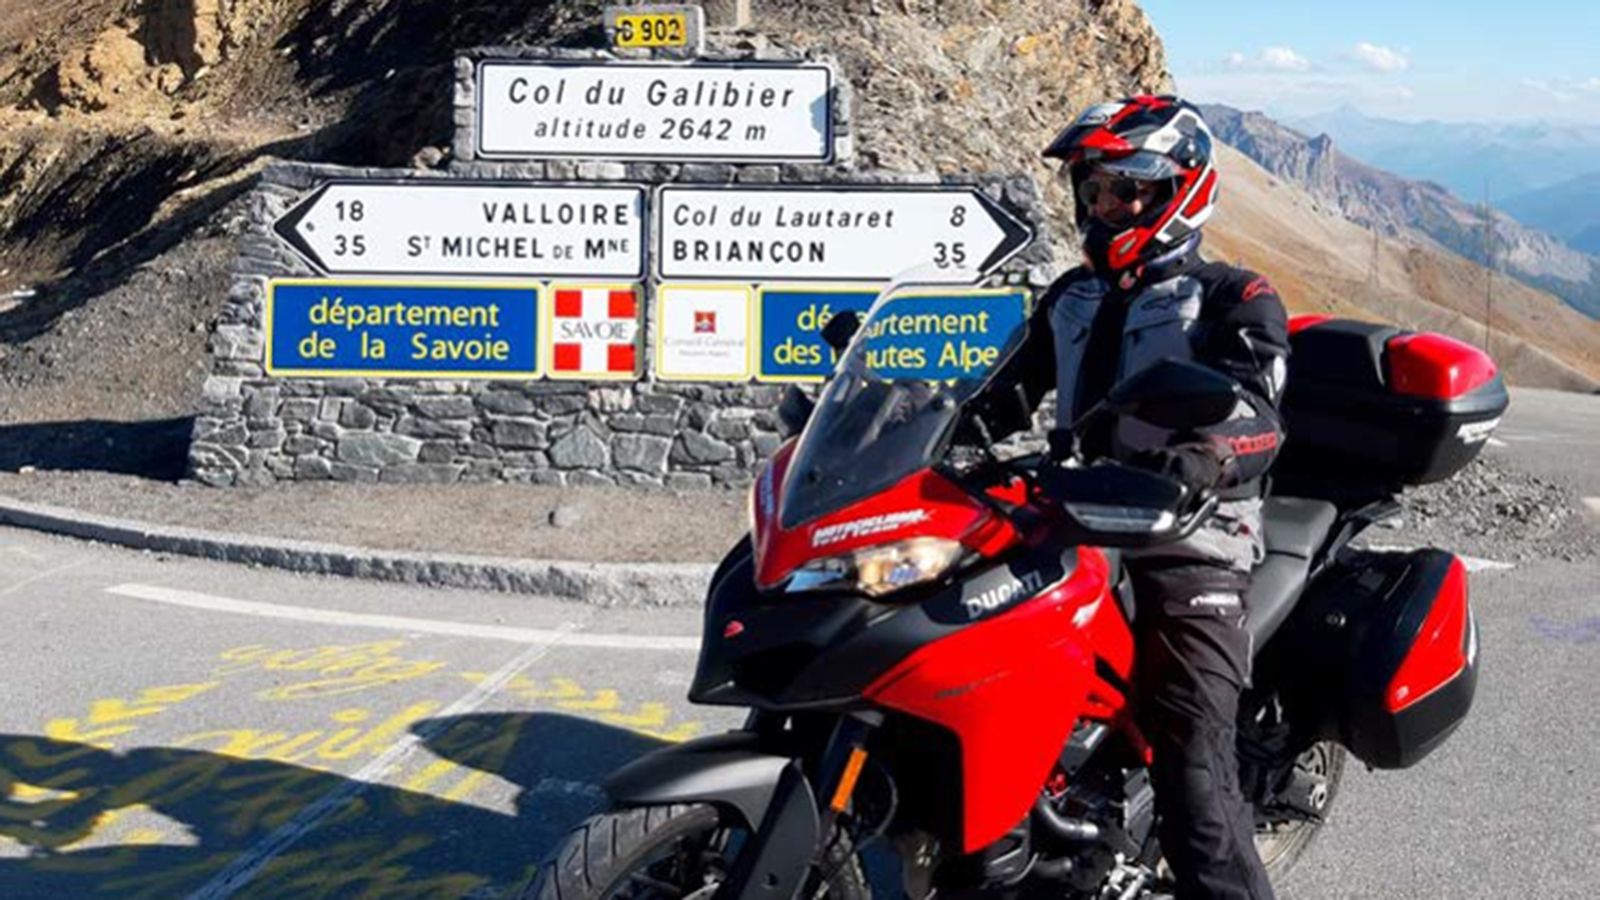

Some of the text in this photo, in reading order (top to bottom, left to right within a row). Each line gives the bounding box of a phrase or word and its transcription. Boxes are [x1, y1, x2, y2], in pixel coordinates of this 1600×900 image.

[641, 18, 681, 42] 902
[508, 77, 794, 108] Col du Galibier
[534, 117, 766, 141] altitude 2642 m
[335, 200, 629, 225] 18 VALLOIRE
[673, 203, 967, 229] Col du Lautaret 8
[334, 234, 366, 257] 35
[442, 236, 544, 259] MICHEL
[553, 245, 574, 260] DE
[673, 239, 966, 264] BRIANÇON 35
[309, 297, 499, 331] département
[797, 304, 989, 338] déartement
[561, 320, 629, 341] SAVOIE
[299, 332, 510, 361] de la Savoie
[774, 337, 821, 364] des
[967, 570, 1042, 619] DUCATI
